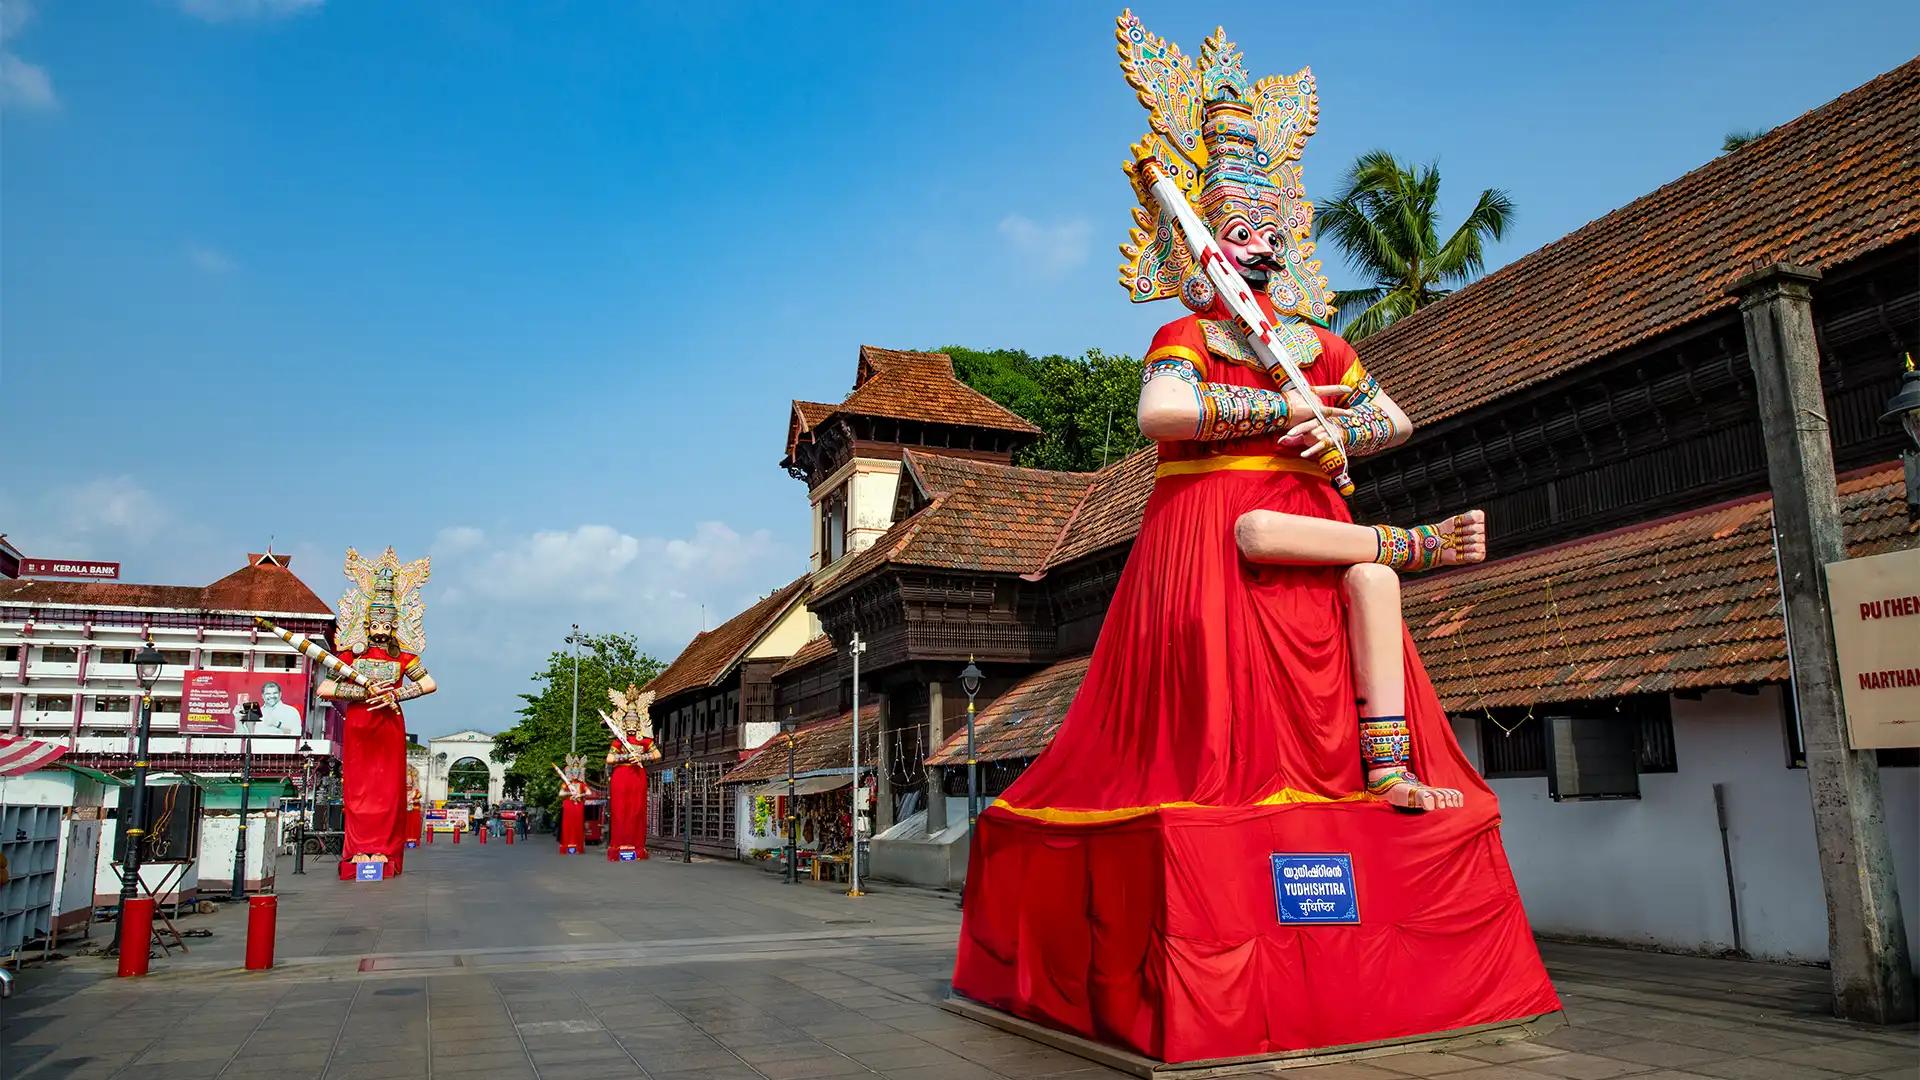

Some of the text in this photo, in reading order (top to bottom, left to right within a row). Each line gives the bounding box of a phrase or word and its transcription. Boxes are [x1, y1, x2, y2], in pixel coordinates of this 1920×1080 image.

[53, 564, 115, 574] KERALA BANK
[1284, 882, 1346, 896] YUDHISHTIRA
[1299, 899, 1335, 916] युधिष्ठिर
